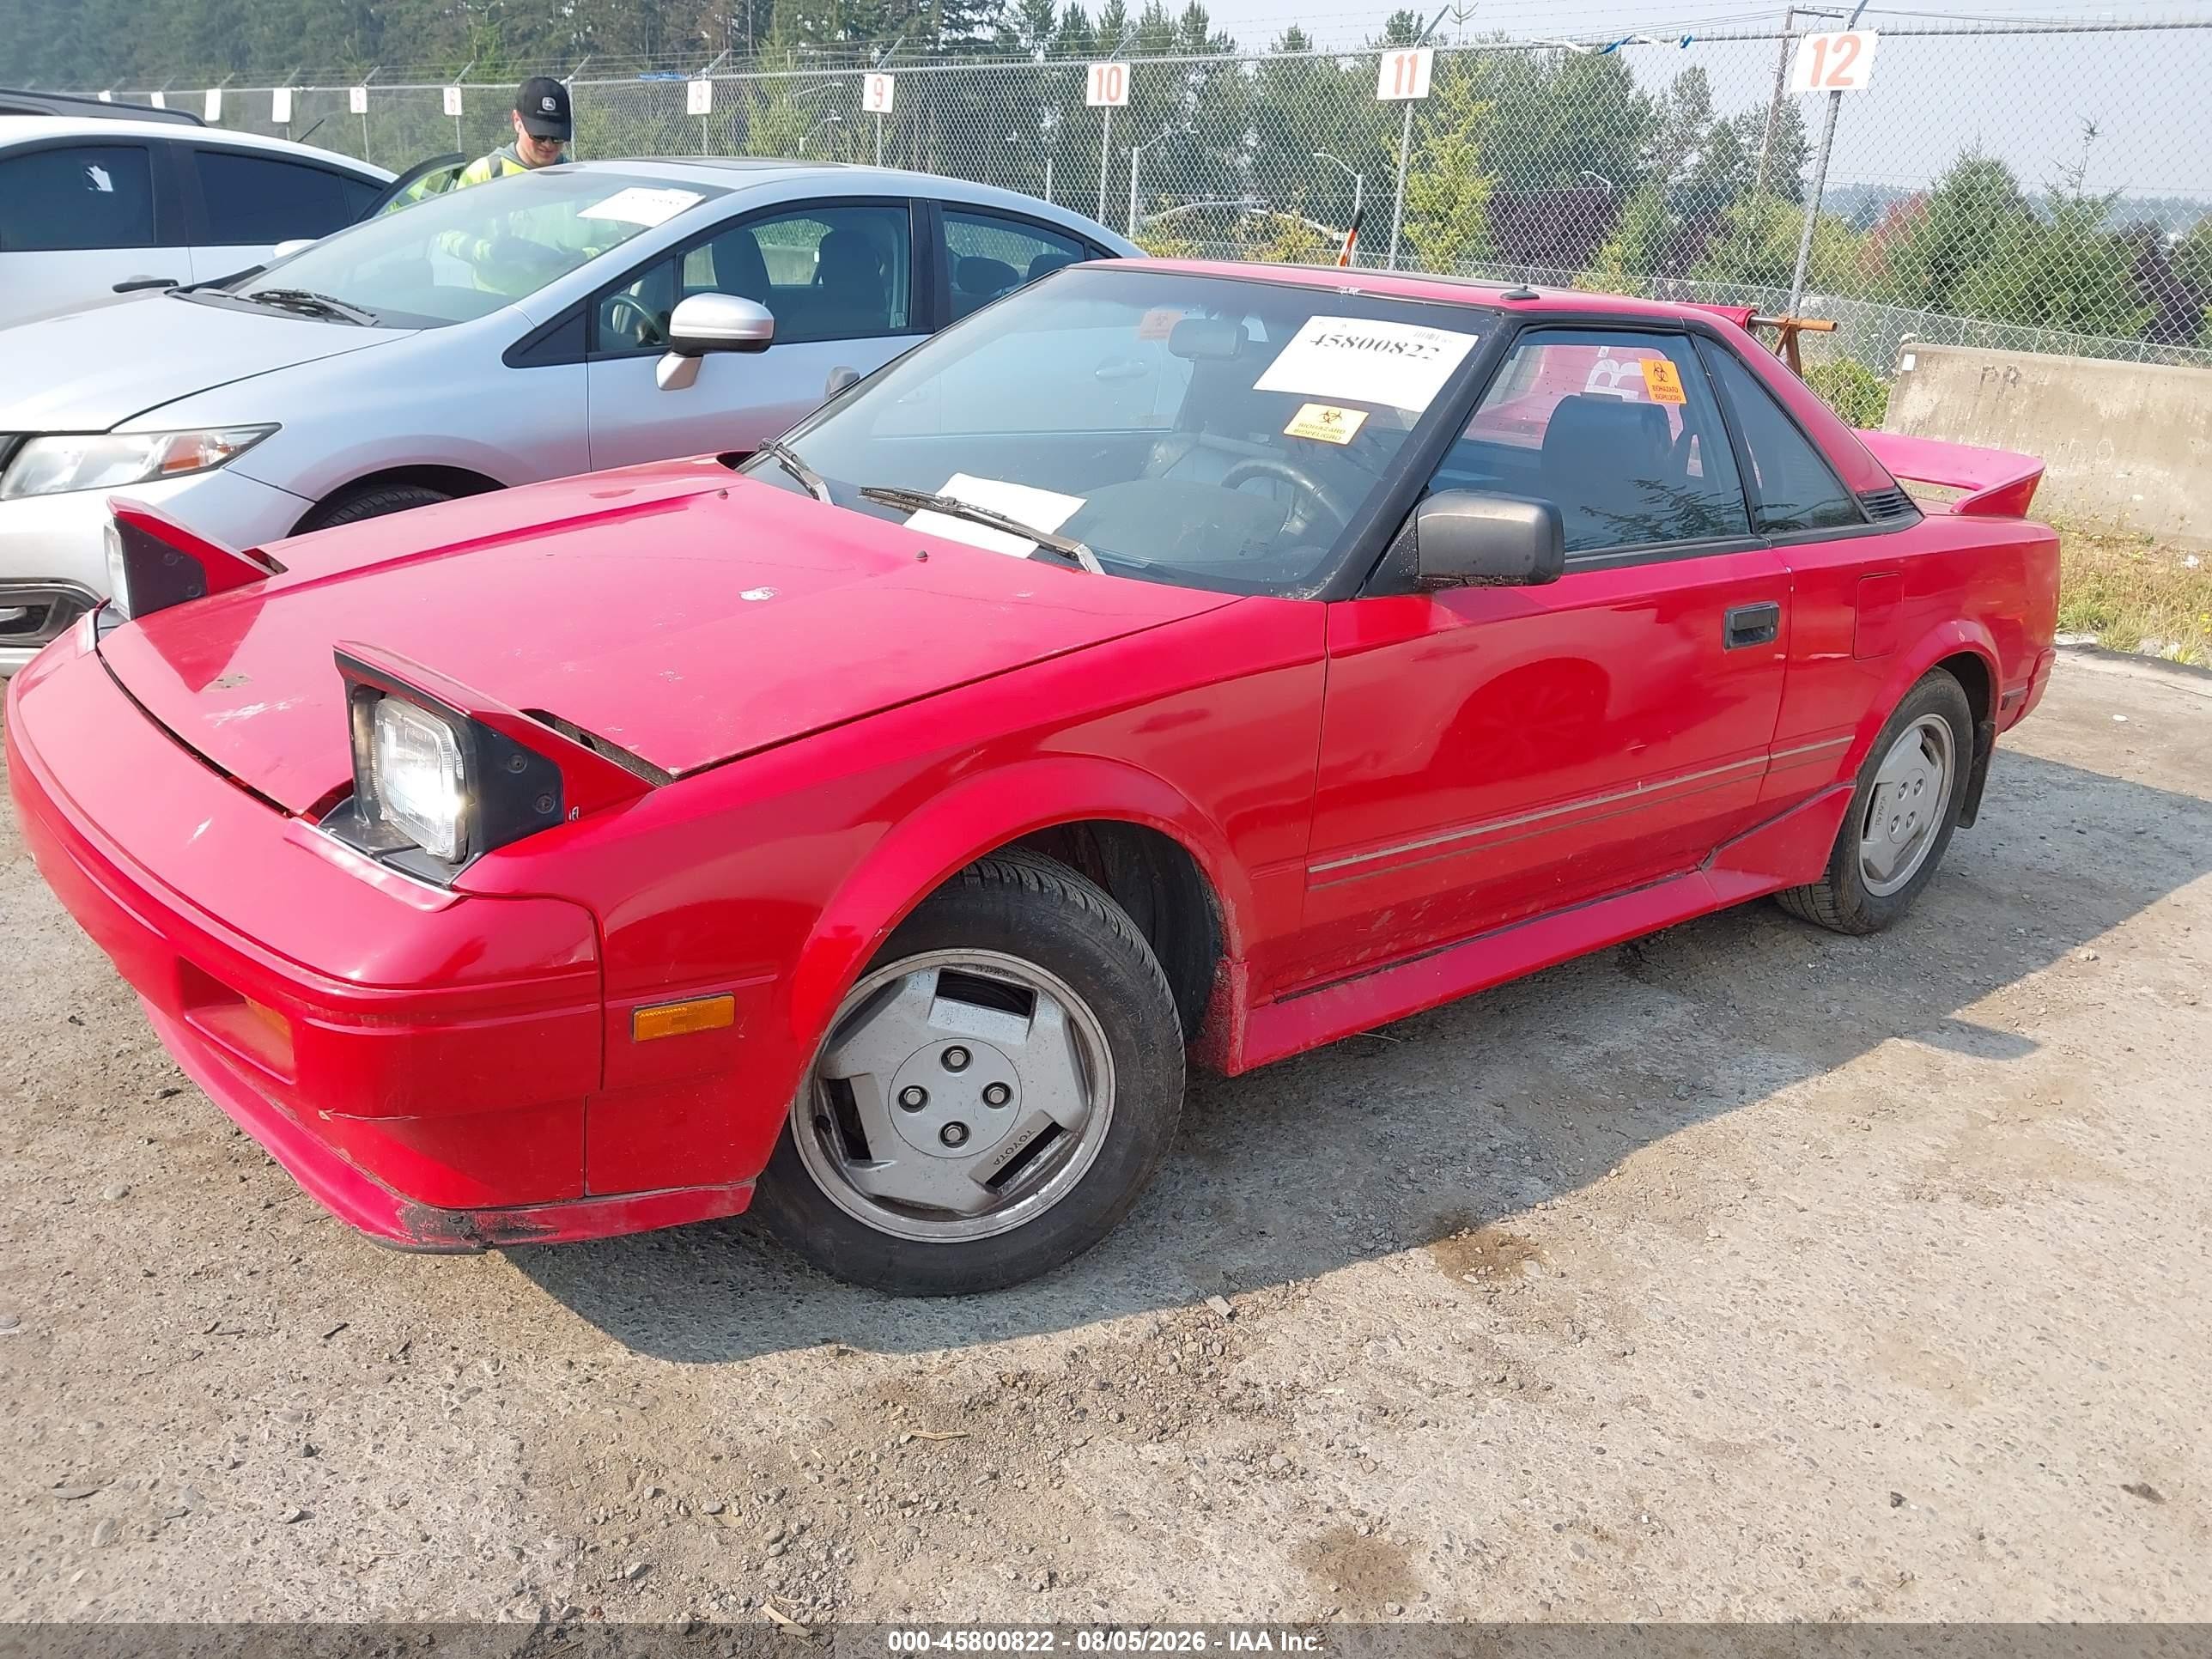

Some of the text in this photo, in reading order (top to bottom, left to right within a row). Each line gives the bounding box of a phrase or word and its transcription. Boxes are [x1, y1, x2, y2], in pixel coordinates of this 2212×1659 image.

[1393, 53, 1419, 96] 11
[1808, 33, 1863, 87] 12
[448, 89, 456, 112] 6
[872, 76, 884, 108] 9
[1096, 65, 1122, 102] 10
[1310, 333, 1443, 361] 45800822
[1297, 422, 1346, 434] BIOHAZARD
[994, 1129, 1036, 1166] TOYOTA
